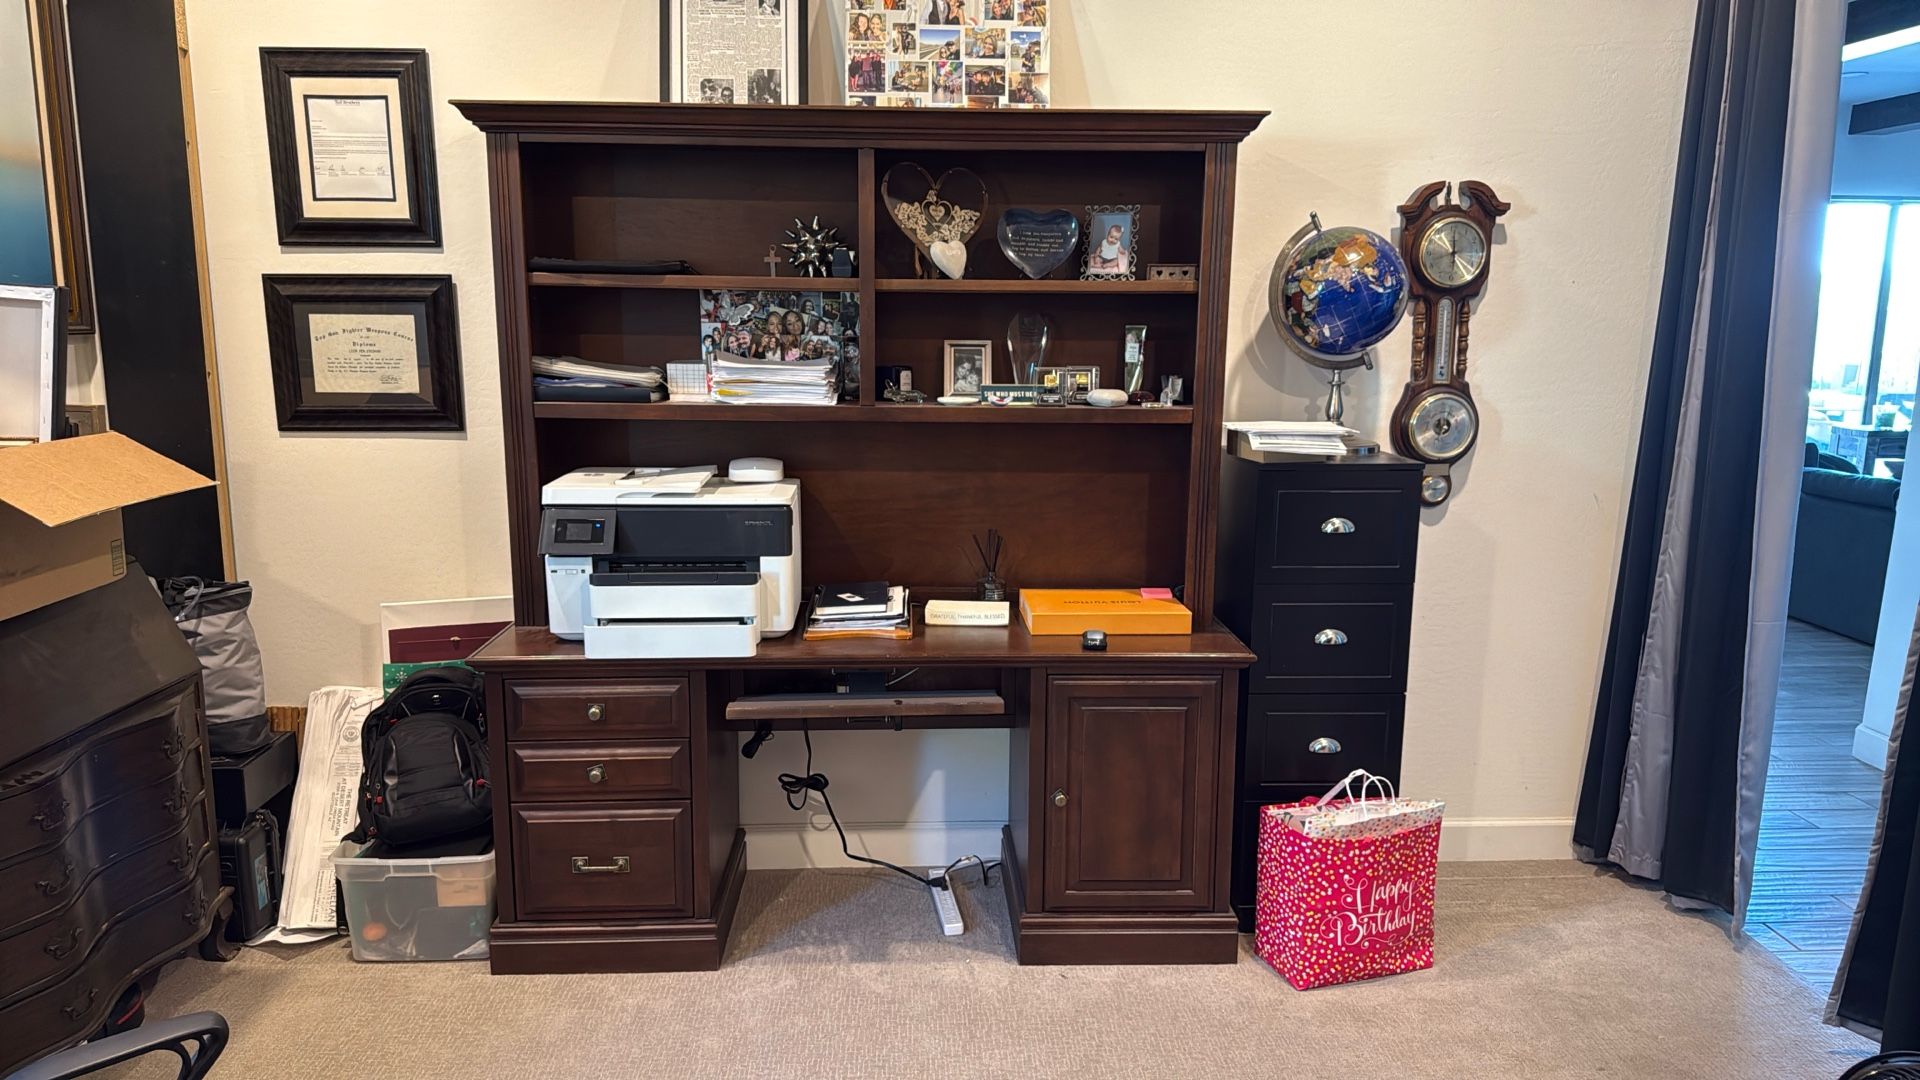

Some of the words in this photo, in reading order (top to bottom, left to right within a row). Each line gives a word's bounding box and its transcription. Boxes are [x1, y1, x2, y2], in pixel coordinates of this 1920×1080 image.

[339, 785, 347, 807] DESERT
[334, 807, 343, 837] MOUNTAIN
[343, 799, 351, 825] RETREAT
[1341, 871, 1427, 914] Happy
[1320, 905, 1416, 950] Birthday
